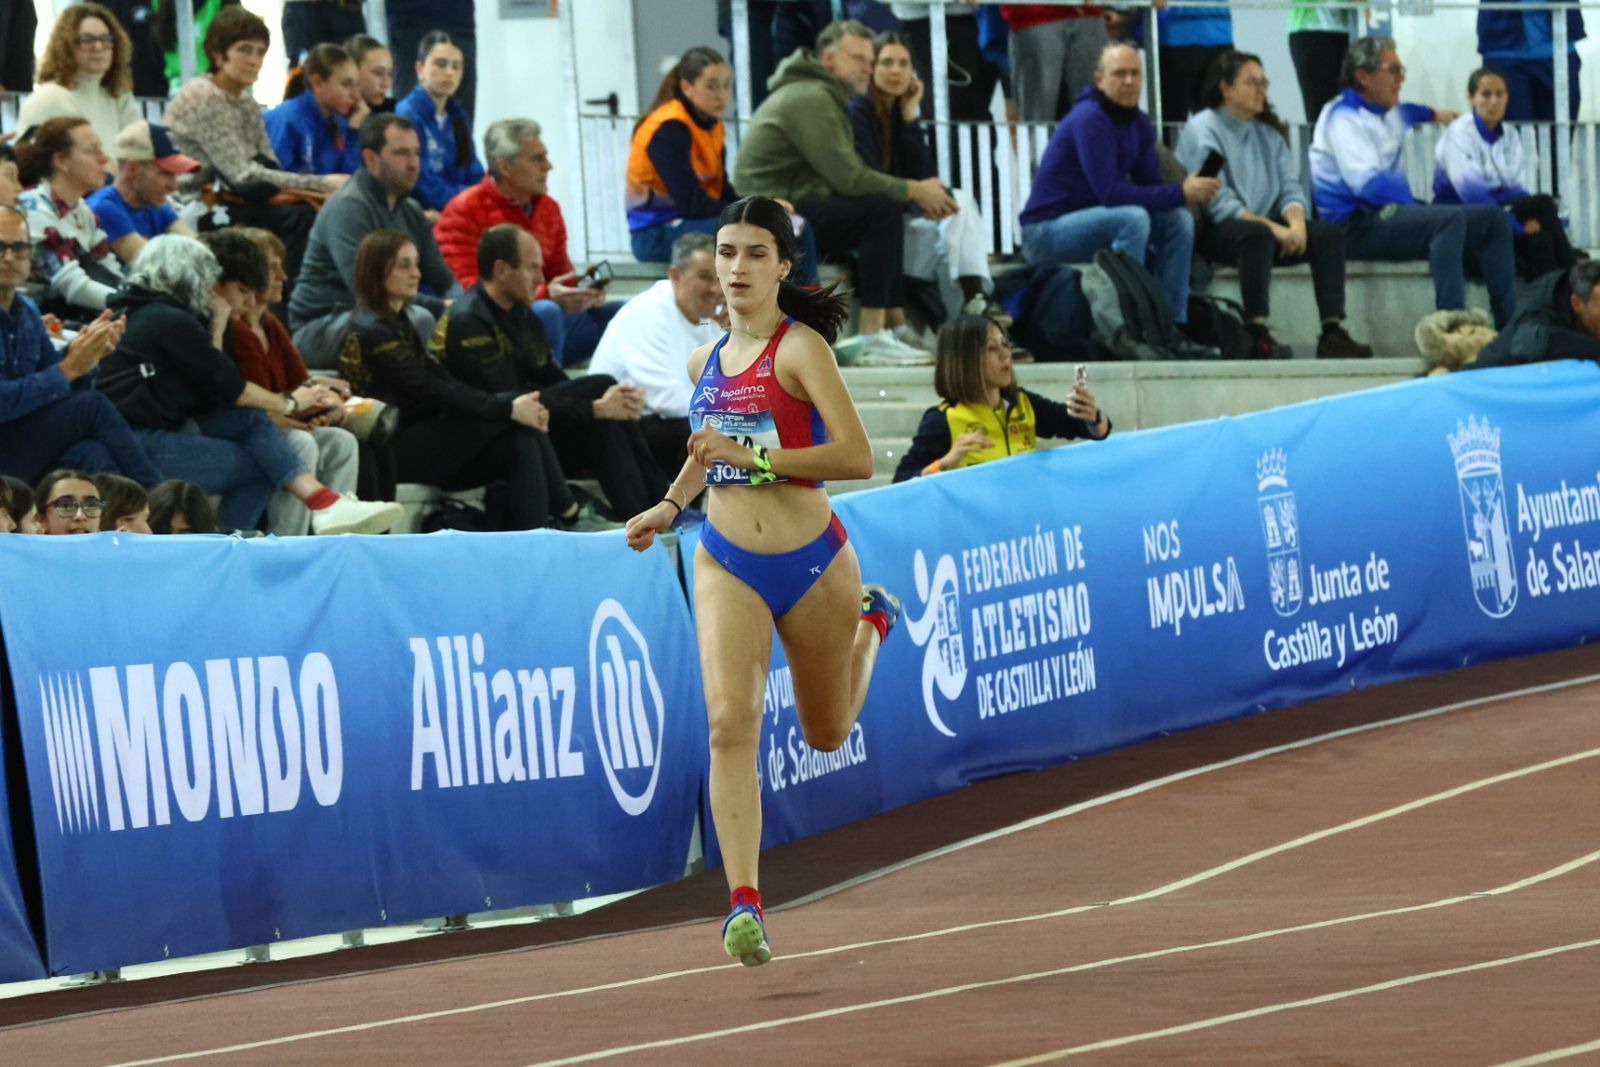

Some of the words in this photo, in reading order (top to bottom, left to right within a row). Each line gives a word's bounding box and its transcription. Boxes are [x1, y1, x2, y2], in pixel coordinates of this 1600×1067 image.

[720, 385, 765, 399] lapalma
[1142, 520, 1181, 564] NOS
[1517, 472, 1600, 542] Ayuntam
[962, 524, 1058, 595] FEDERACIÓN
[1063, 525, 1086, 572] DE
[1308, 561, 1362, 605] Junta
[1365, 551, 1391, 592] de
[1526, 547, 1551, 597] de
[972, 581, 1092, 662] ATLETISMO
[1147, 556, 1245, 636] IMPULSA
[1263, 620, 1332, 671] Castilla
[1334, 623, 1346, 668] y
[1349, 606, 1398, 651] León
[409, 632, 585, 790] Allianz
[976, 673, 996, 720] DE
[995, 658, 1054, 714] CASTILLA
[1051, 655, 1061, 699] Y
[1062, 640, 1097, 697] LEÓN
[88, 652, 344, 831] MONDO
[768, 733, 787, 792] de
